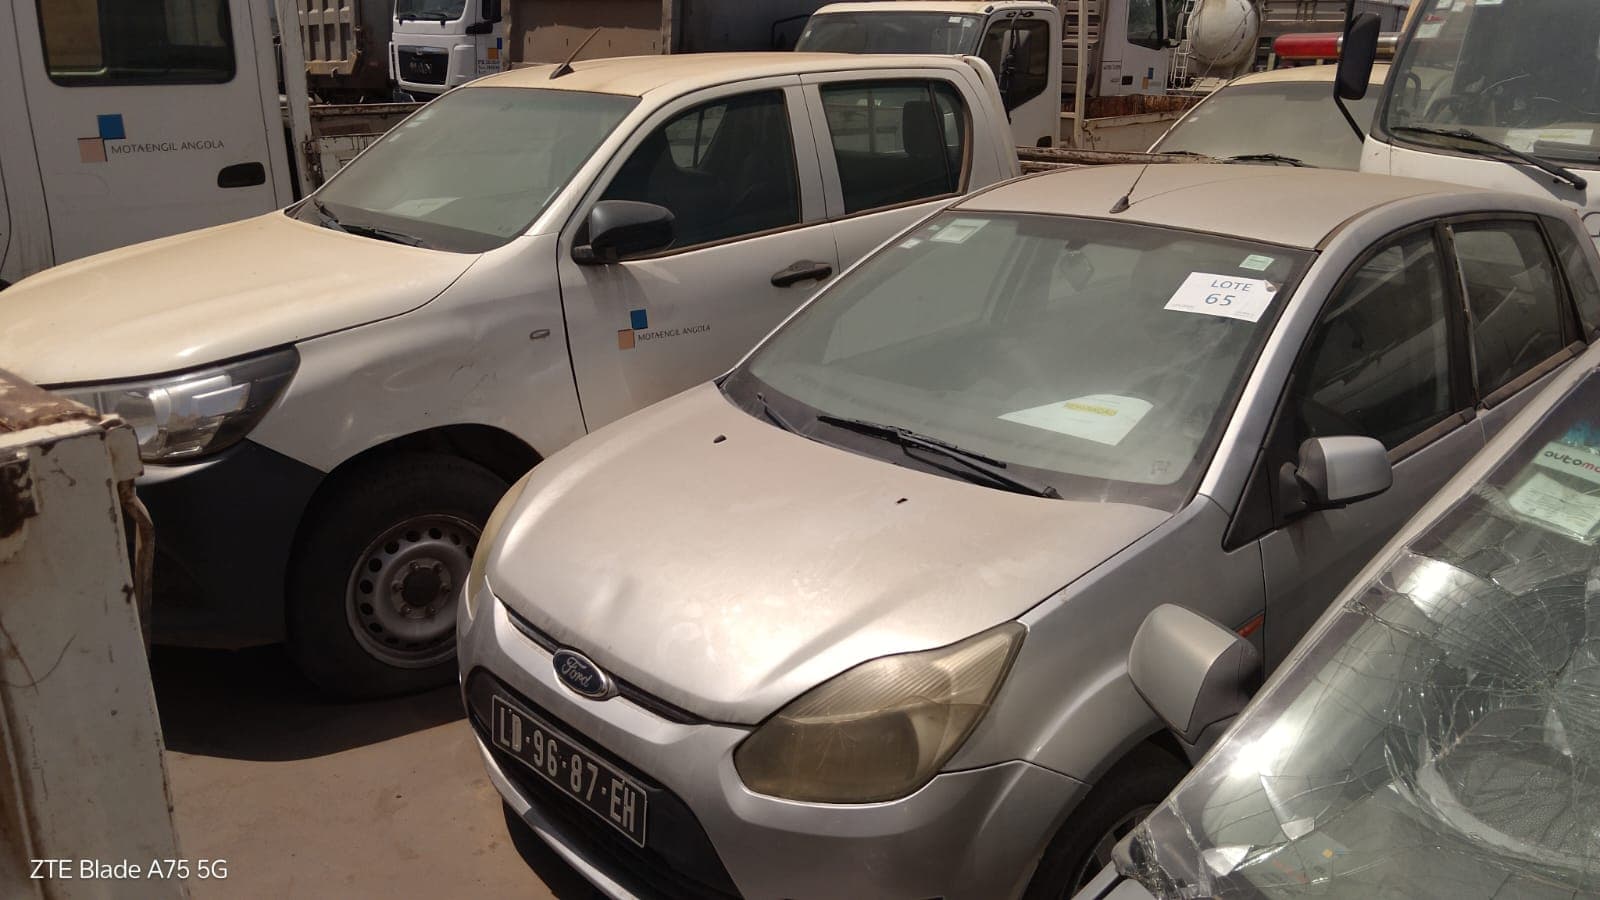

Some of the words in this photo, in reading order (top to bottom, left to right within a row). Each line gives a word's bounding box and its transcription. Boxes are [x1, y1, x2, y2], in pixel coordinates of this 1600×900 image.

[181, 140, 225, 151] ANGOLA
[1211, 279, 1253, 292] LOTE
[1205, 293, 1236, 306] 65
[682, 324, 711, 335] ANGOLA
[561, 656, 593, 688] Ford
